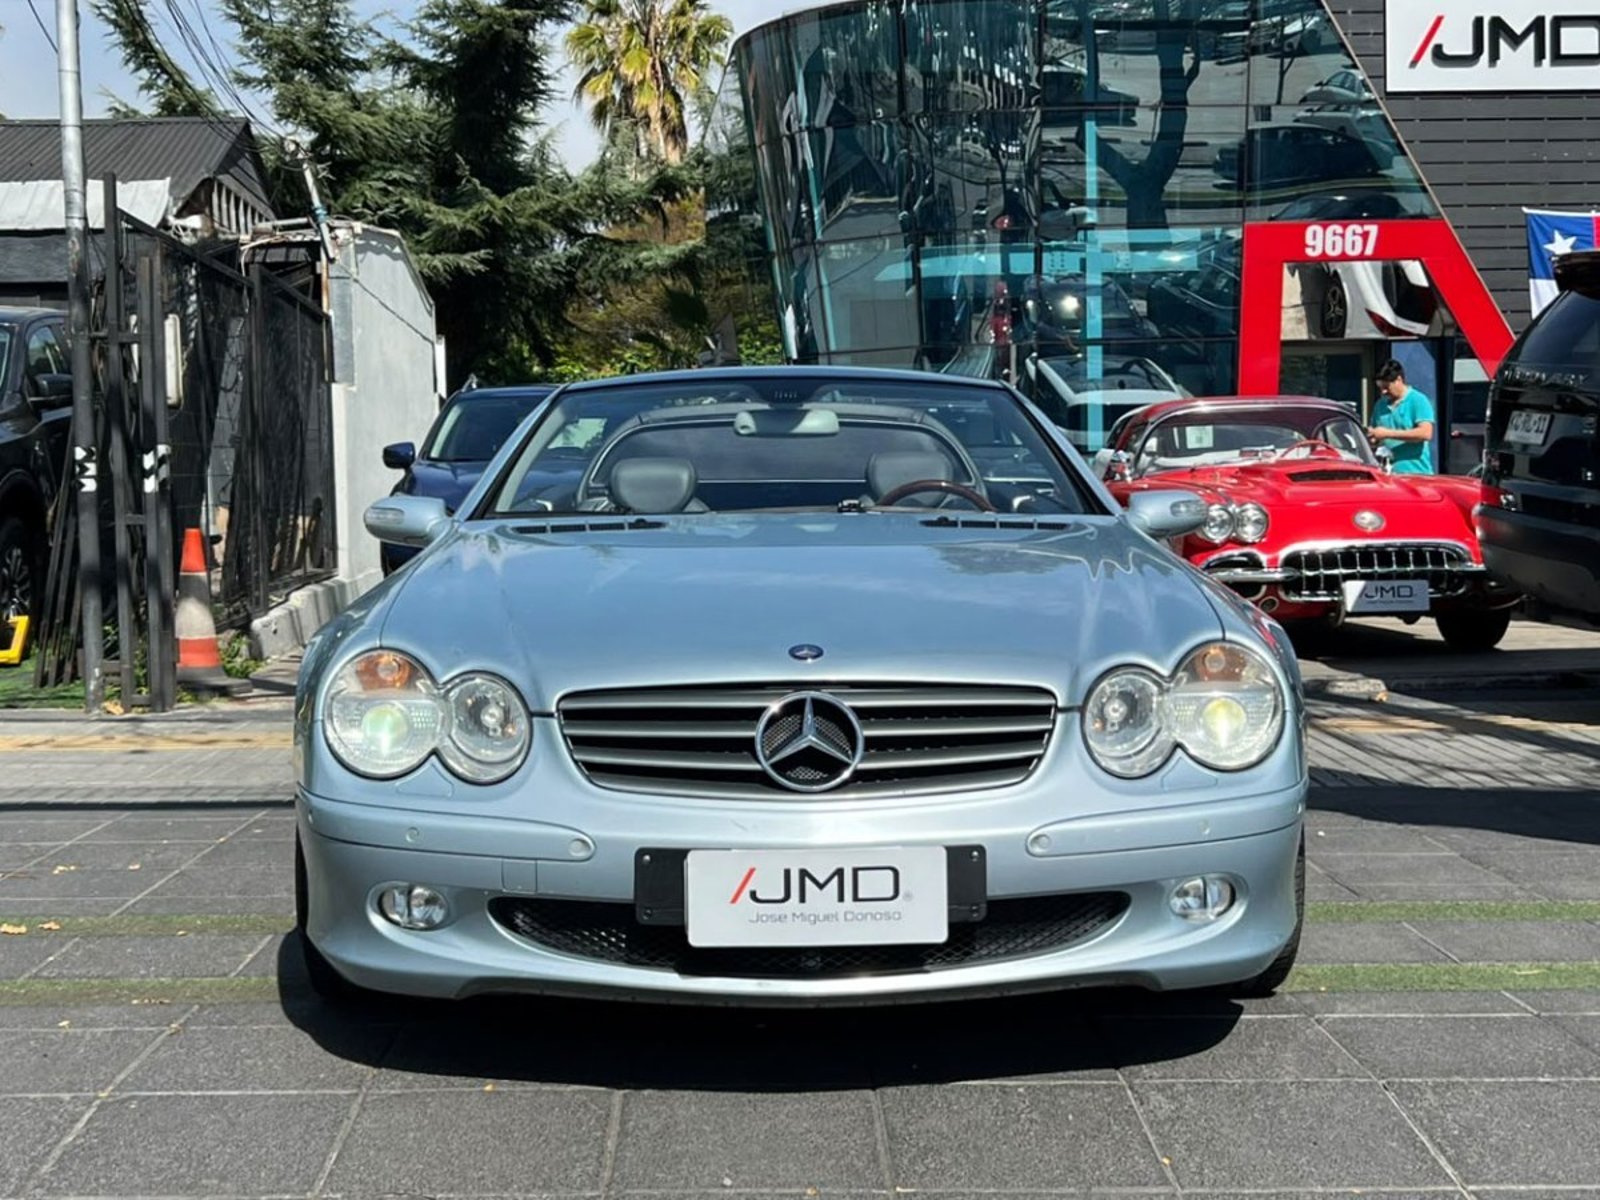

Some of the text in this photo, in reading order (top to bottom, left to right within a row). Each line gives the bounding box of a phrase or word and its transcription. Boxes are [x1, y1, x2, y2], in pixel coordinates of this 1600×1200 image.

[1304, 224, 1379, 257] 9667
[792, 910, 840, 925] Miguel
[843, 910, 902, 922] Donoso
